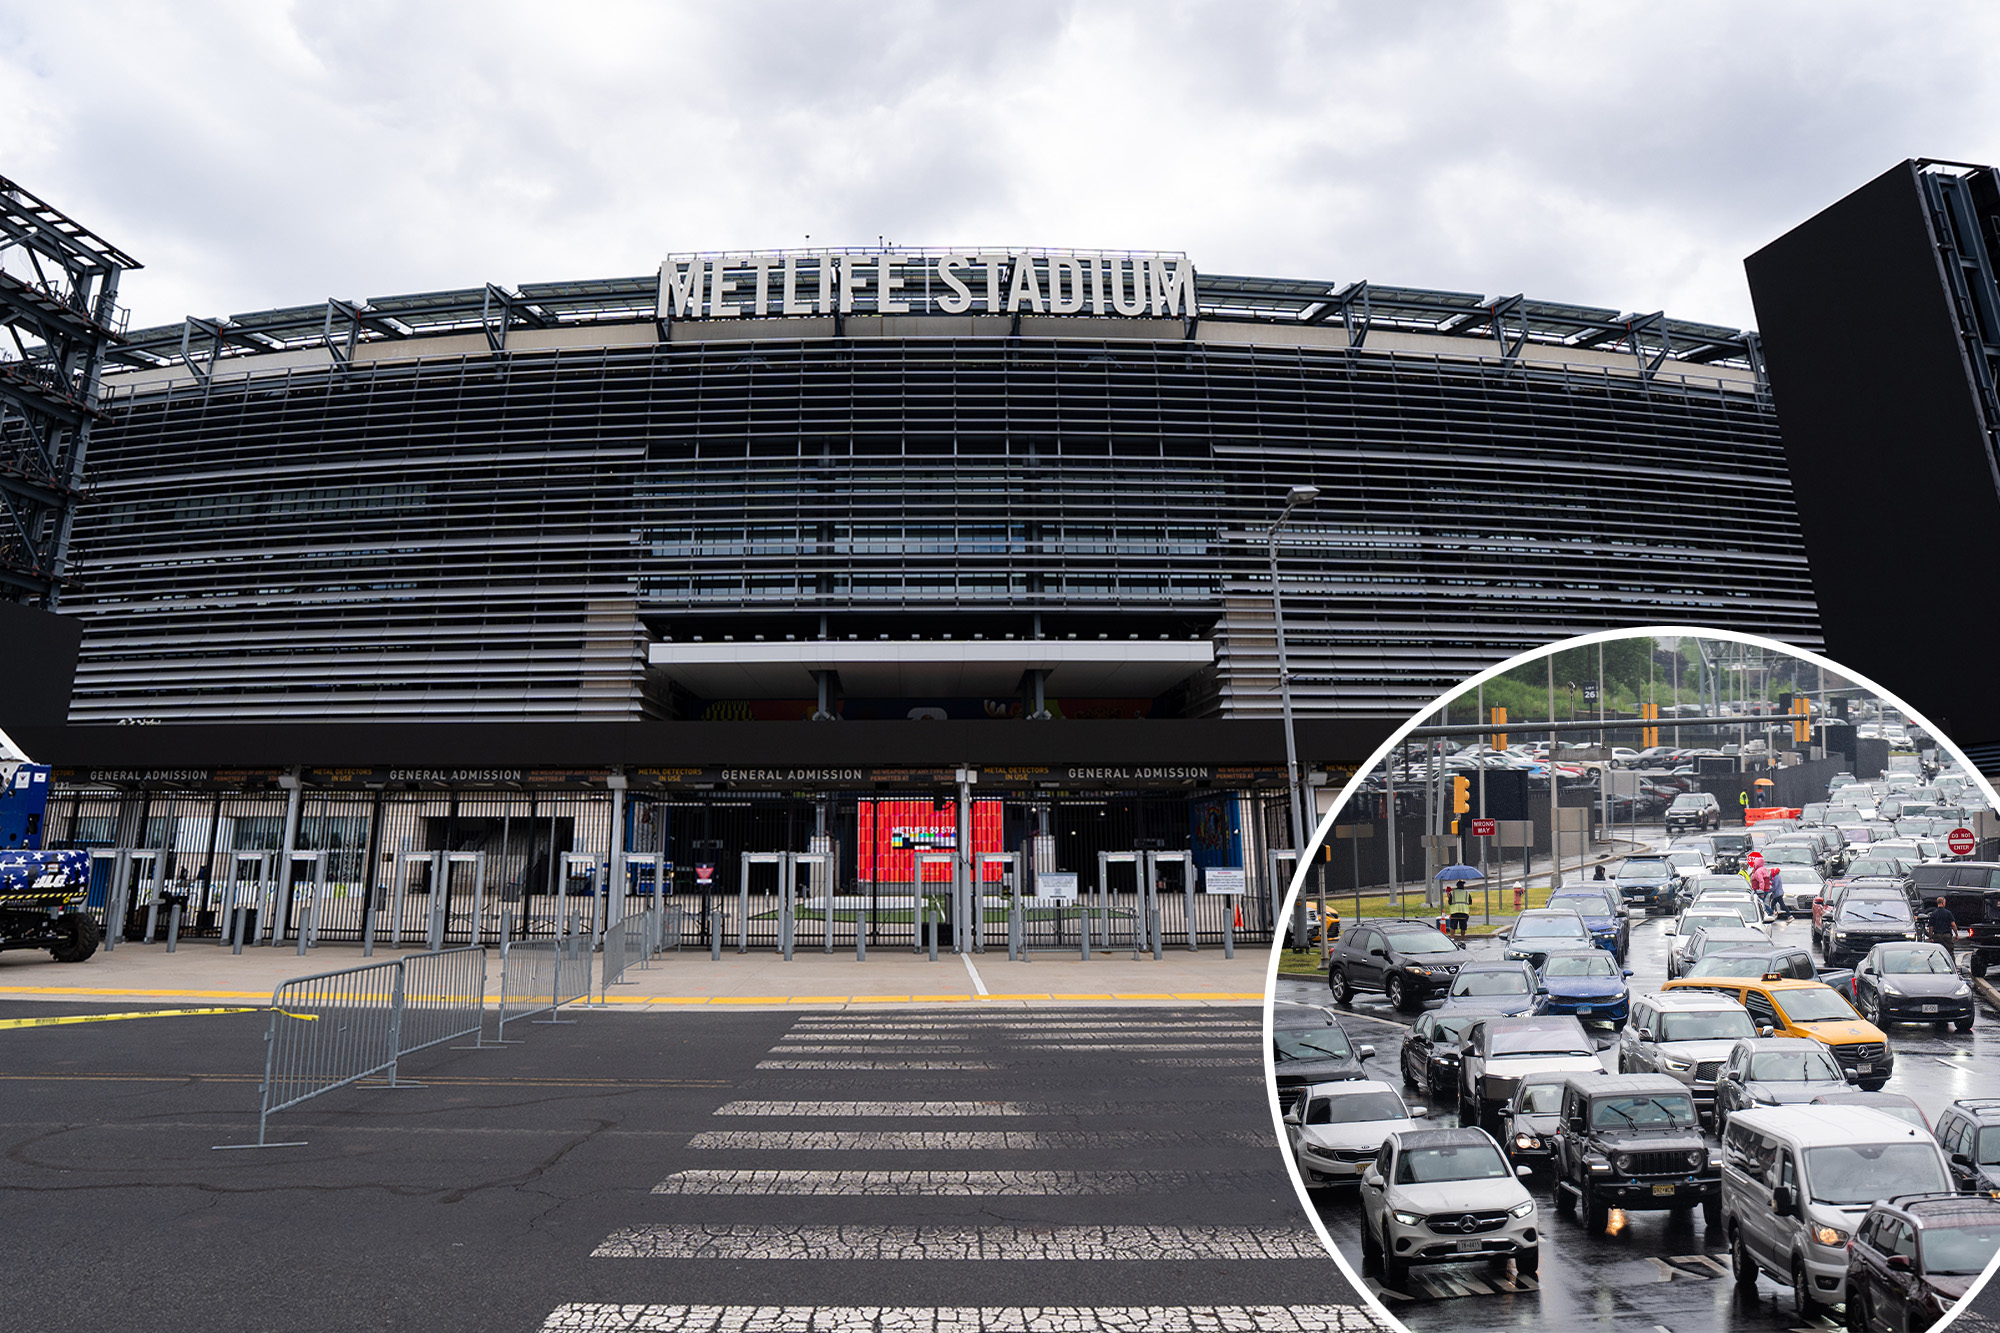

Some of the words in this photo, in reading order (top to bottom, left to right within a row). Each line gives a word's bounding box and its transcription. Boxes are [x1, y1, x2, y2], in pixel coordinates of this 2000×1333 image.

[657, 255, 910, 318] METLIFE
[936, 254, 1197, 317] STADIUM
[1584, 691, 1596, 699] 26
[90, 770, 142, 781] GENERAL
[143, 770, 208, 781] ADMISSION
[389, 769, 447, 781] GENERAL
[450, 769, 521, 781] ADMISSION
[638, 768, 661, 776] METAL
[662, 768, 702, 776] DETECTORS
[721, 769, 783, 780] GENERAL
[787, 769, 862, 780] ADMISSION
[984, 767, 1007, 775] METAL
[1008, 767, 1049, 775] DETECTORS
[1068, 767, 1130, 779] GENERAL
[1134, 766, 1208, 778] ADMISSION
[892, 826, 929, 834] METLIFE
[31, 874, 68, 889] JLG
